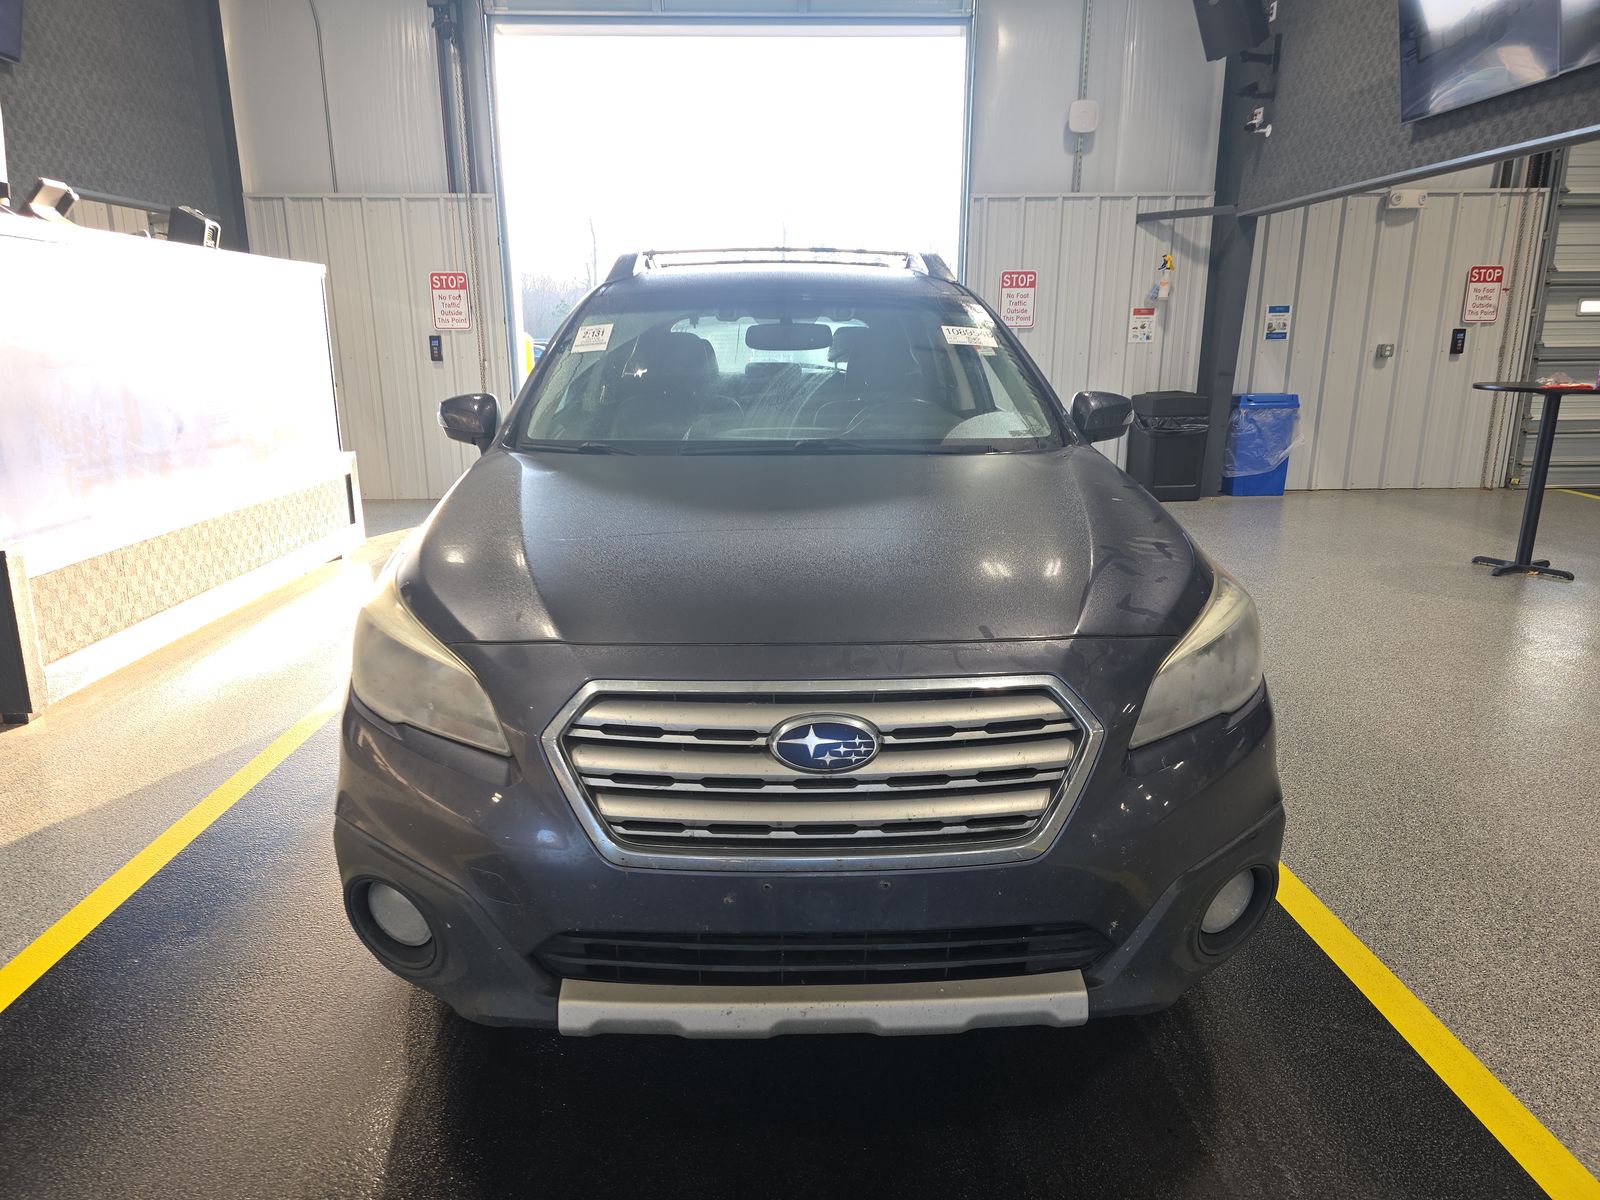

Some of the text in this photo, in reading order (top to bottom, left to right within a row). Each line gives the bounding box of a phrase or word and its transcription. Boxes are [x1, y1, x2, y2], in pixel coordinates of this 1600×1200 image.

[1003, 274, 1035, 287] STOP
[1471, 269, 1502, 281] STOP
[432, 276, 465, 288] STOP
